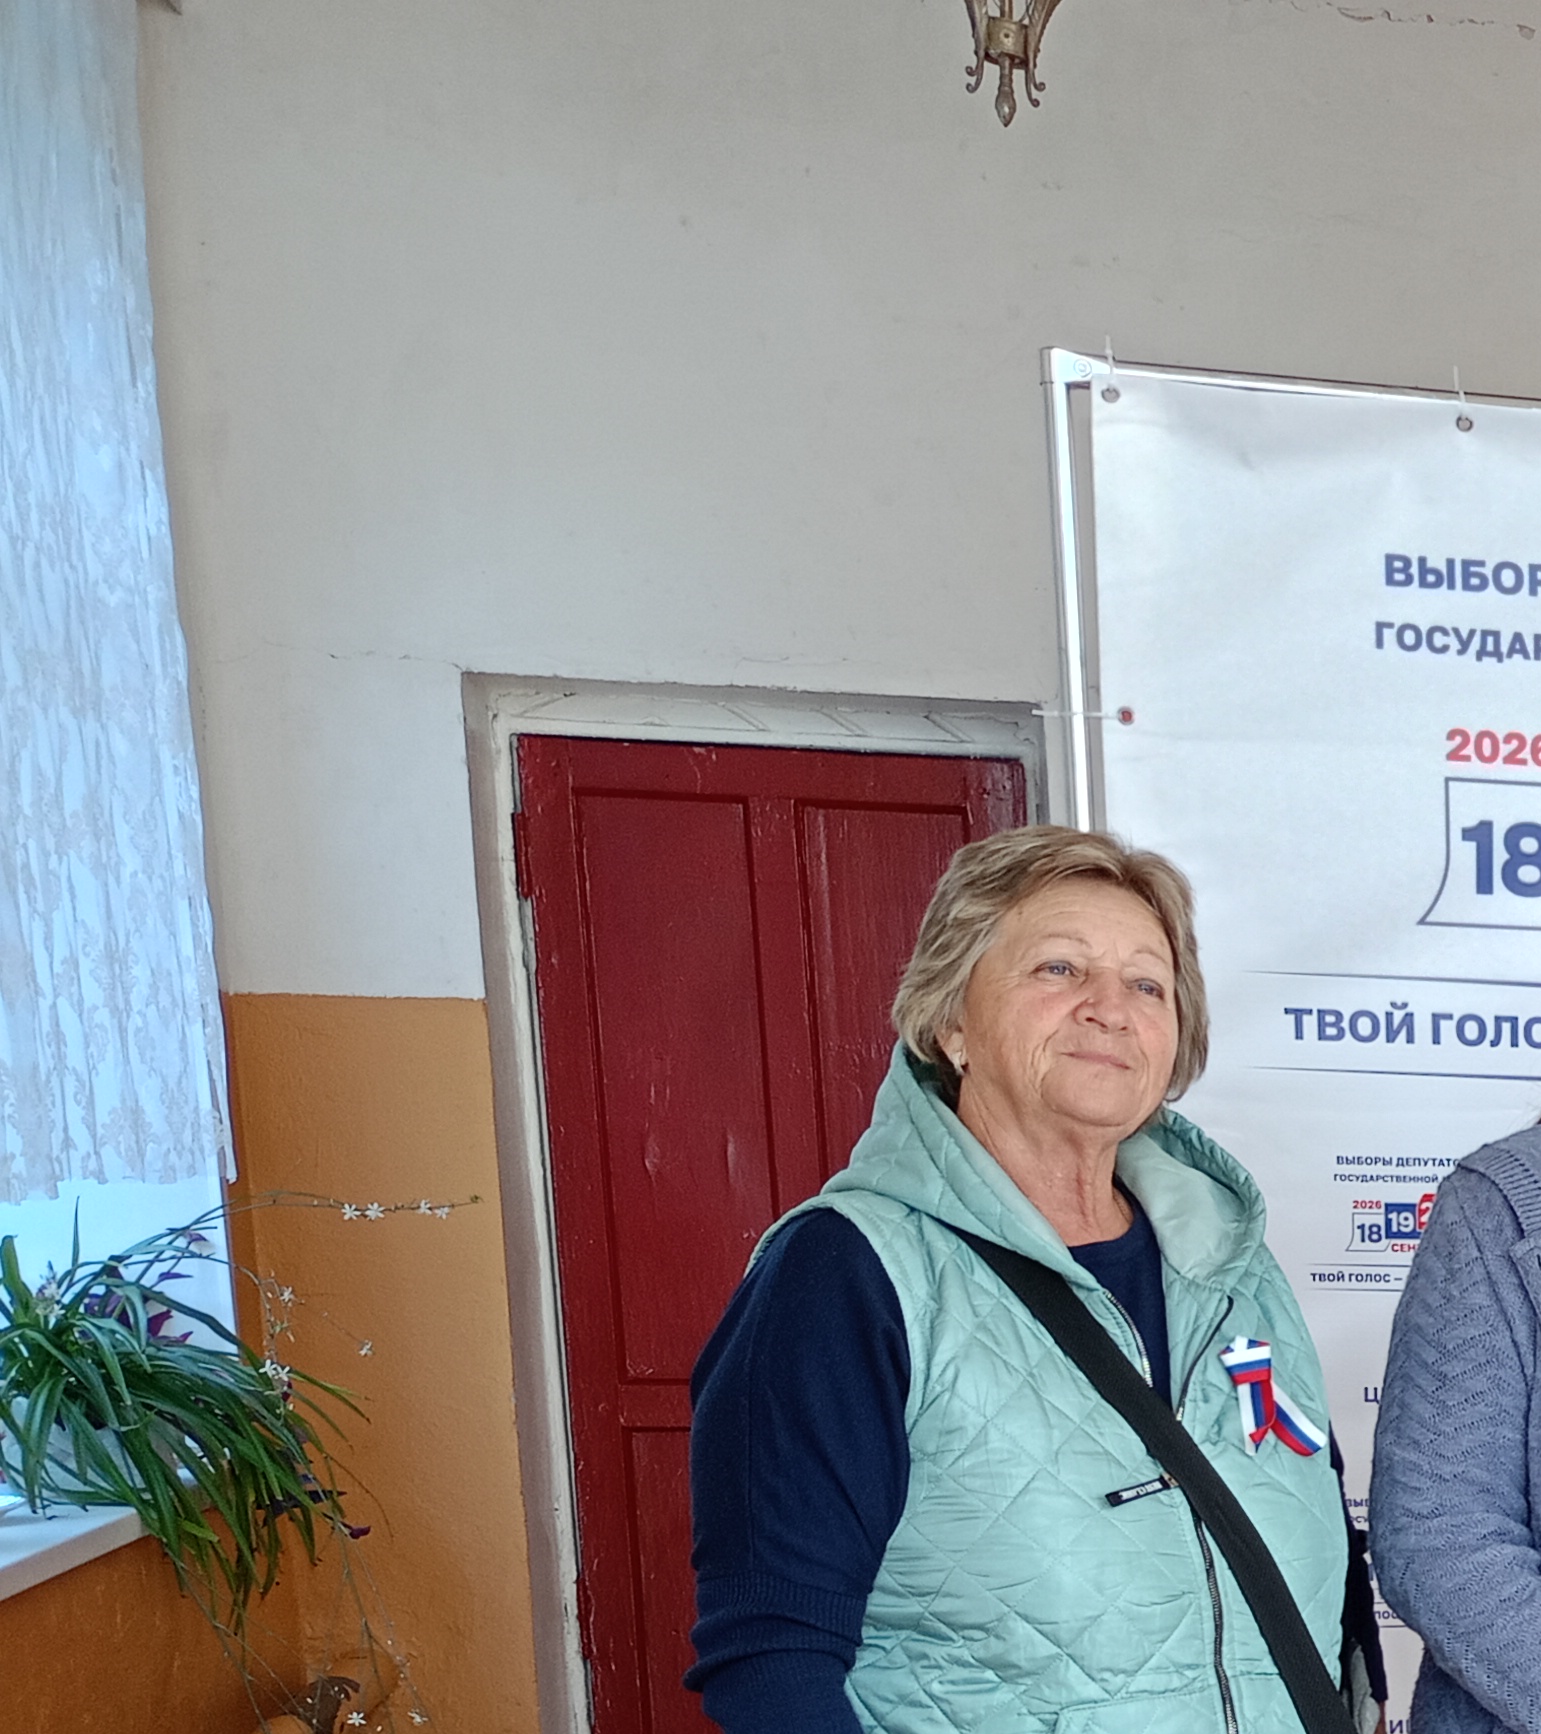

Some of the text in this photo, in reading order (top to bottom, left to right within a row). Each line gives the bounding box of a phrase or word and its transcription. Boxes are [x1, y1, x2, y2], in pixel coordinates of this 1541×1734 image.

[1284, 1001, 1415, 1044] ТВОЙ
[1336, 1155, 1459, 1168] ВЫБОРЫ ДЕПУТАТО
[1333, 1173, 1439, 1184] ГОСУДАРСТВЕННОЙ
[1352, 1200, 1382, 1210] 2026
[1387, 1211, 1415, 1233] 19
[1356, 1223, 1383, 1243] 18
[1310, 1271, 1345, 1283] ТВОЙ
[1349, 1272, 1391, 1283] ГОЛОС
